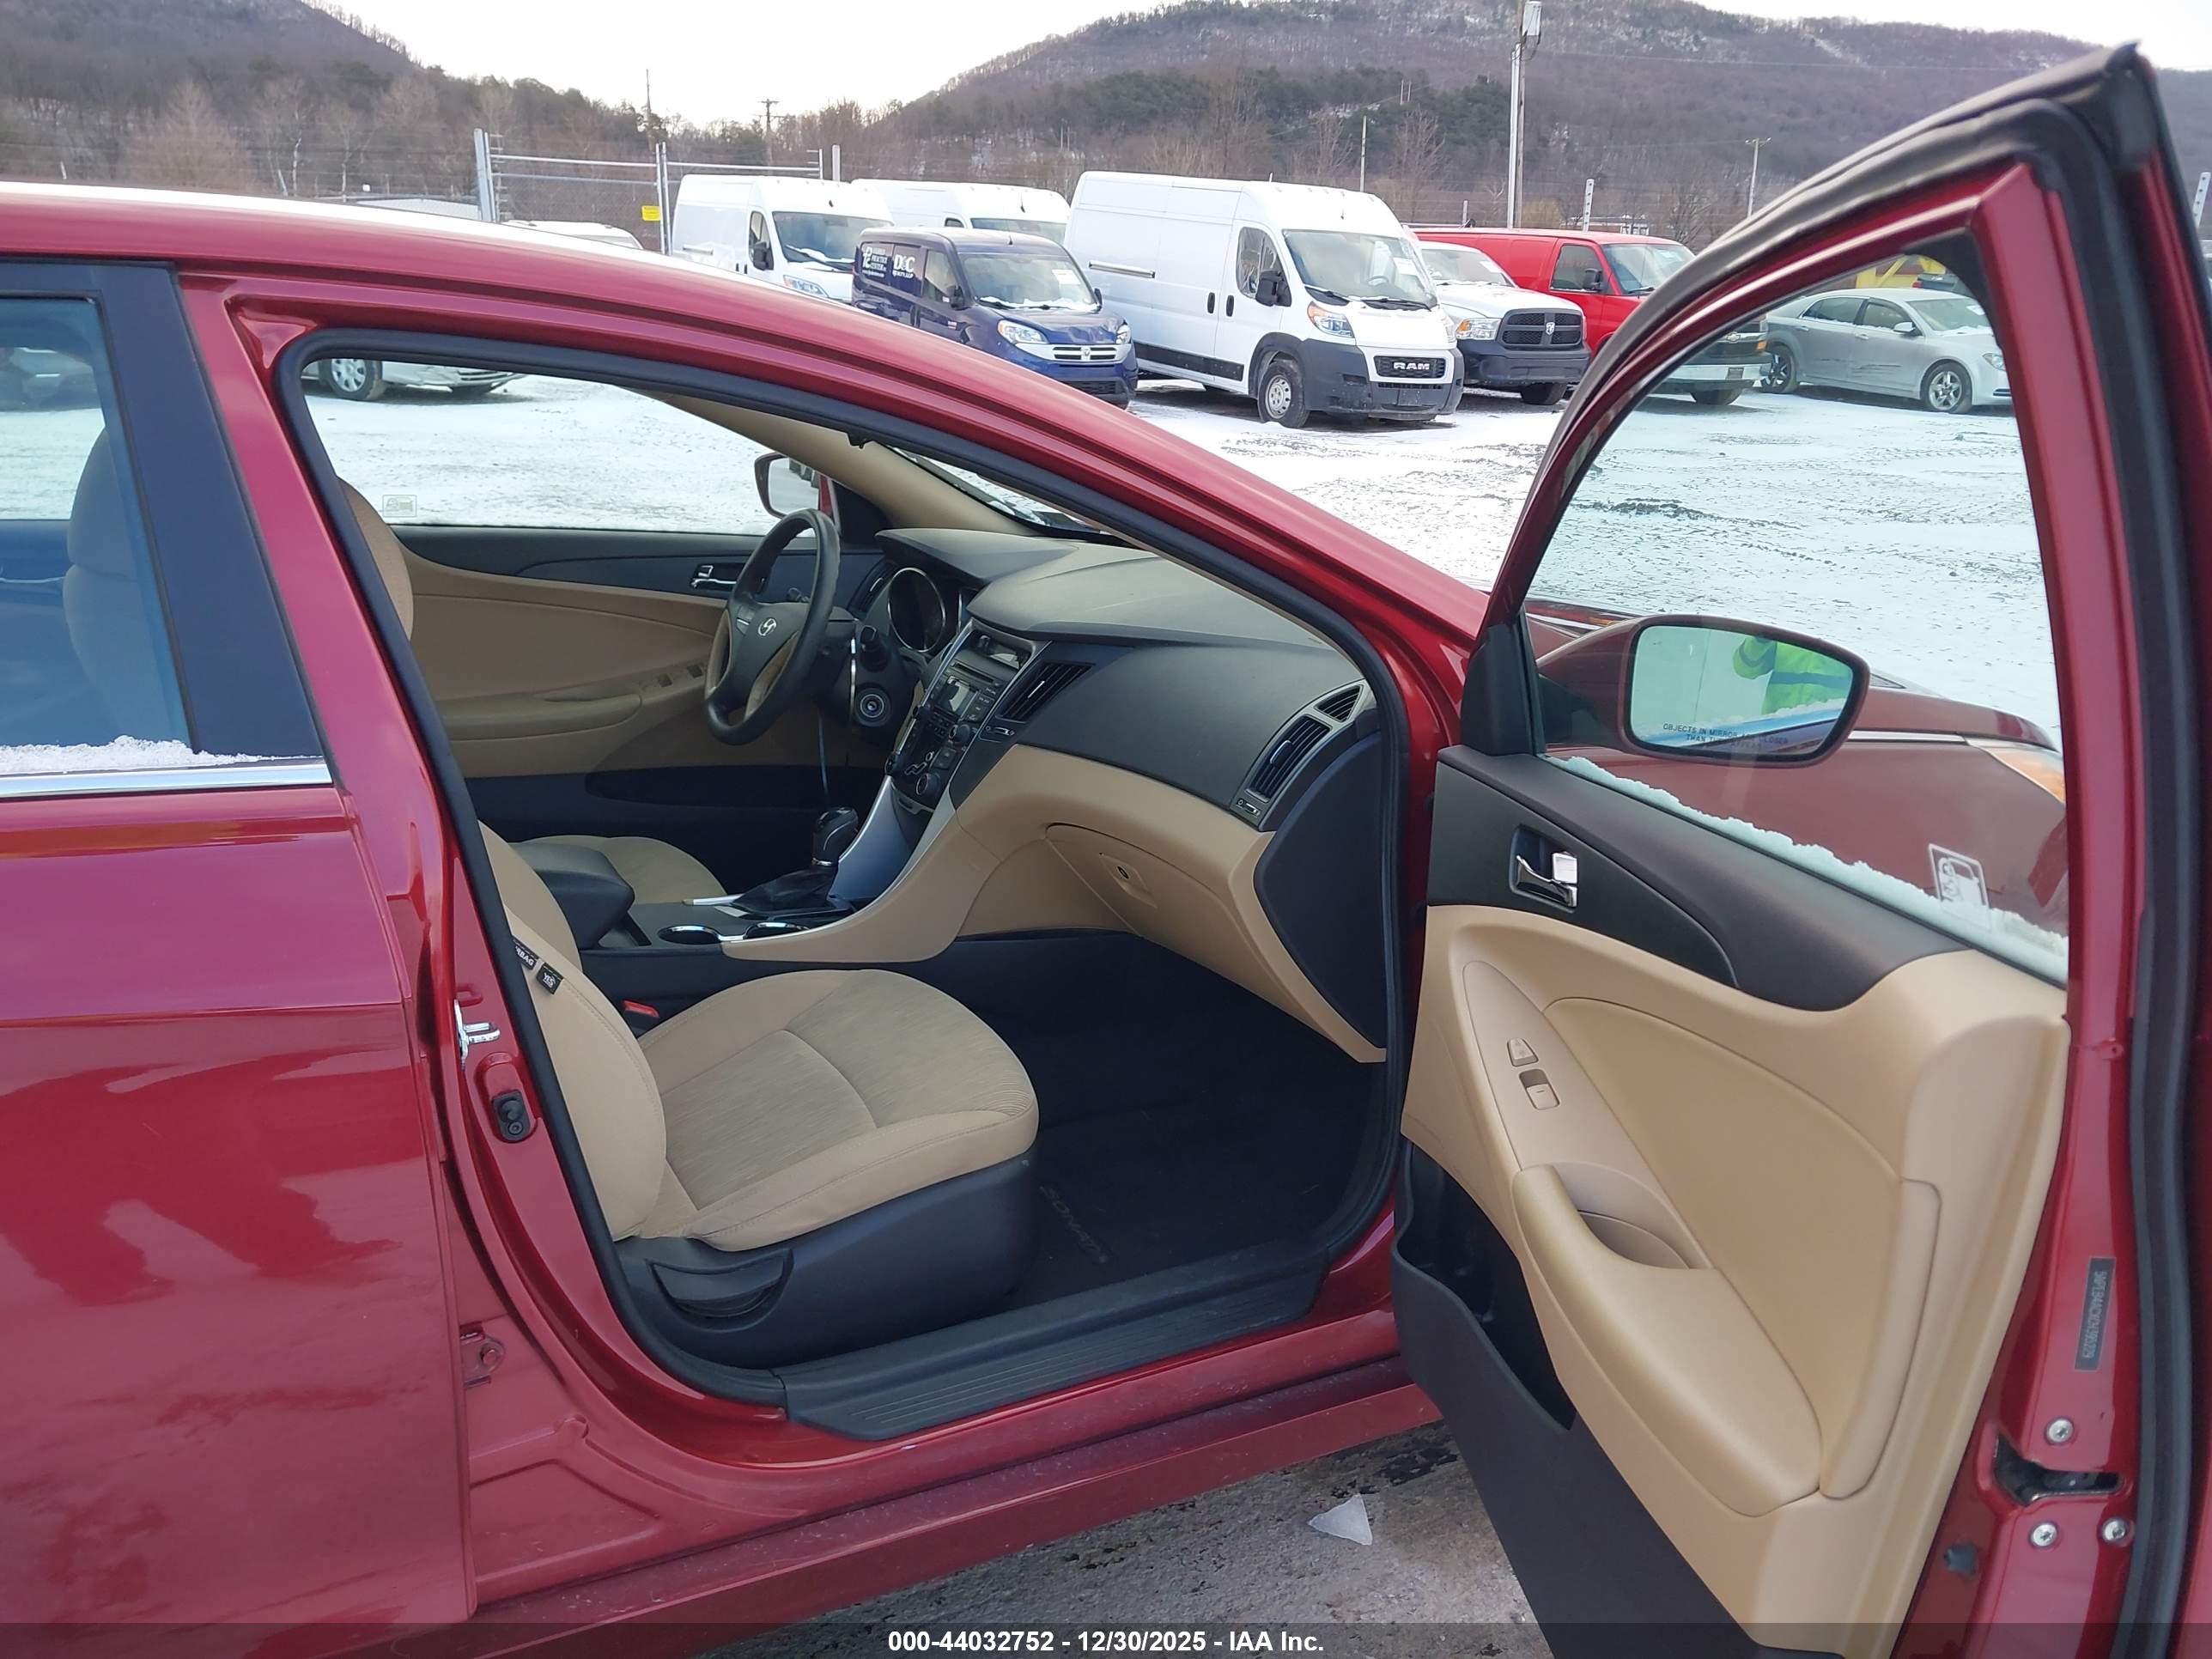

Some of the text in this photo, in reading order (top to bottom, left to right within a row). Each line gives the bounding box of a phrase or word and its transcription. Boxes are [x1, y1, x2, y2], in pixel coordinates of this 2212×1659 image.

[1394, 362, 1430, 370] RAM
[1662, 723, 1698, 732] OBJECTS
[1709, 727, 1738, 737] MIRROR
[1686, 733, 1705, 742] THAN
